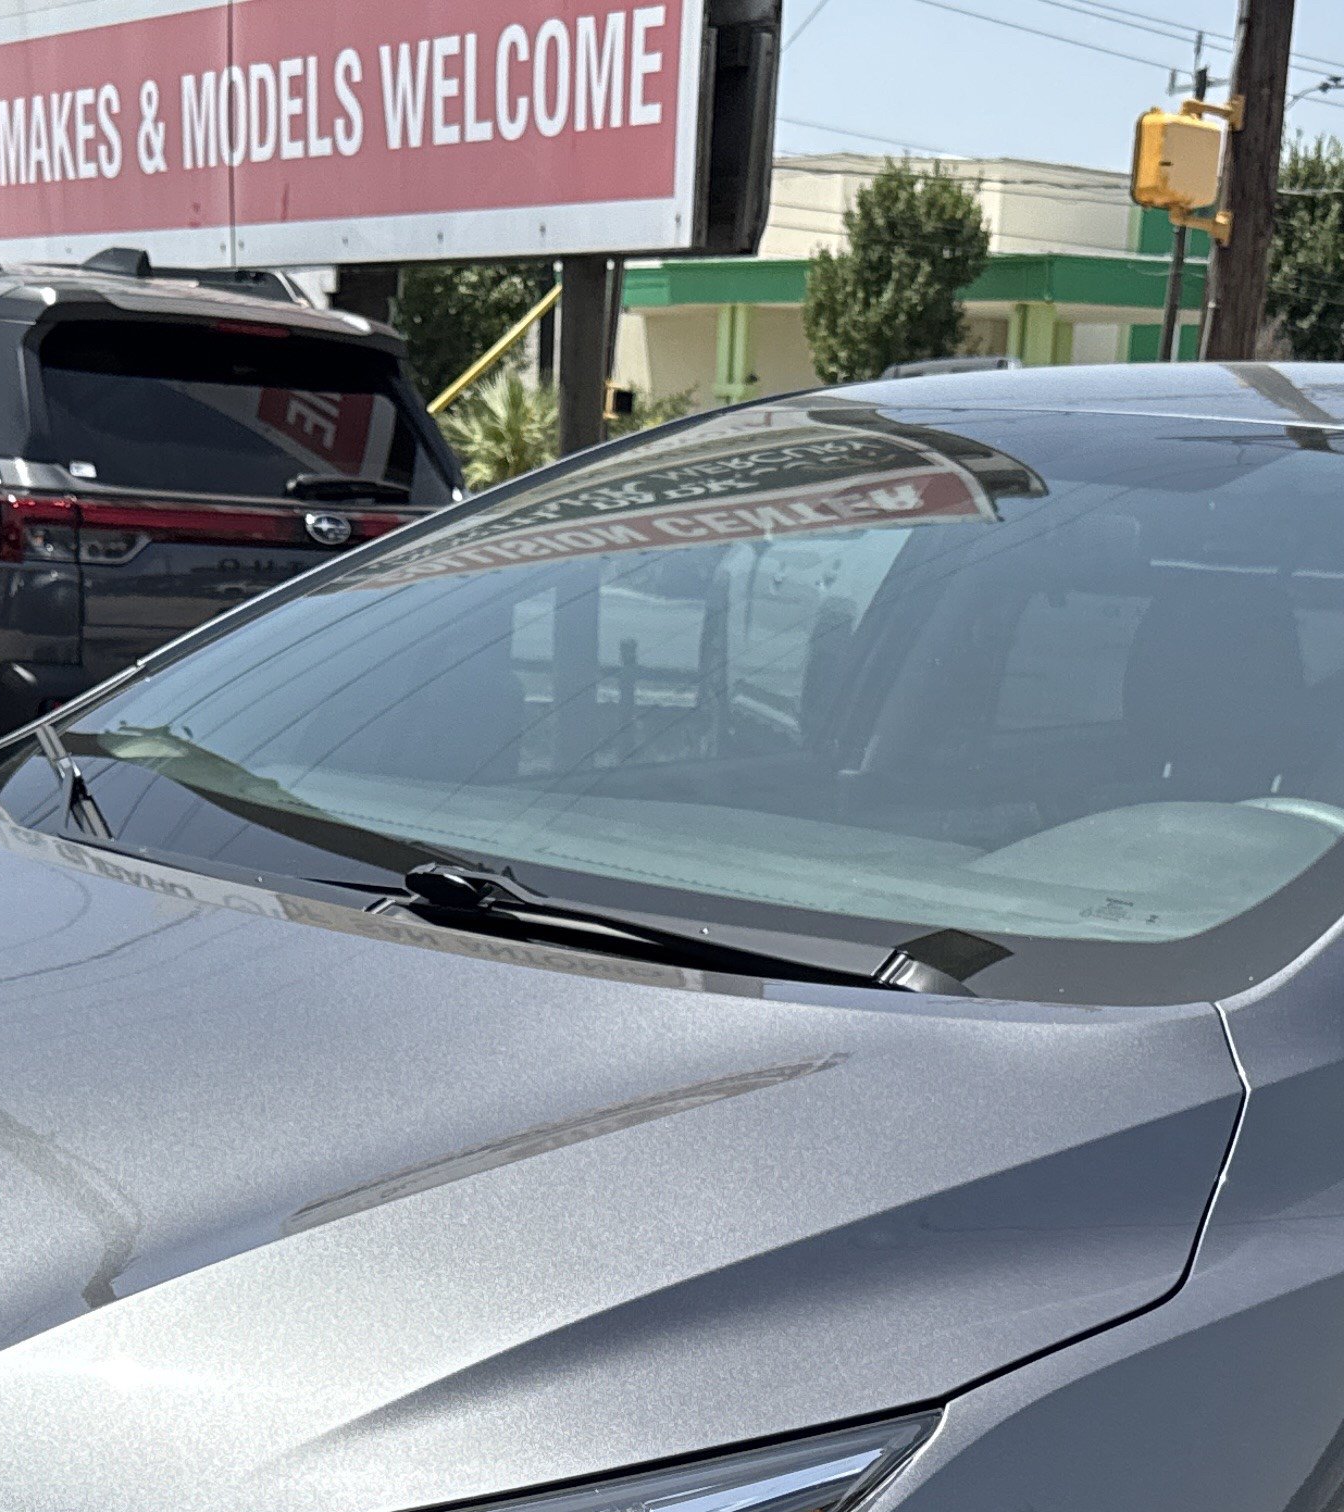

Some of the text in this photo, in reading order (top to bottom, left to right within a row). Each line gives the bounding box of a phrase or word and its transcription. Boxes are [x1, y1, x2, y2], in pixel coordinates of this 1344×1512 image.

[137, 80, 167, 175] &
[181, 48, 363, 171] MODELS
[379, 5, 666, 150] WELCOME
